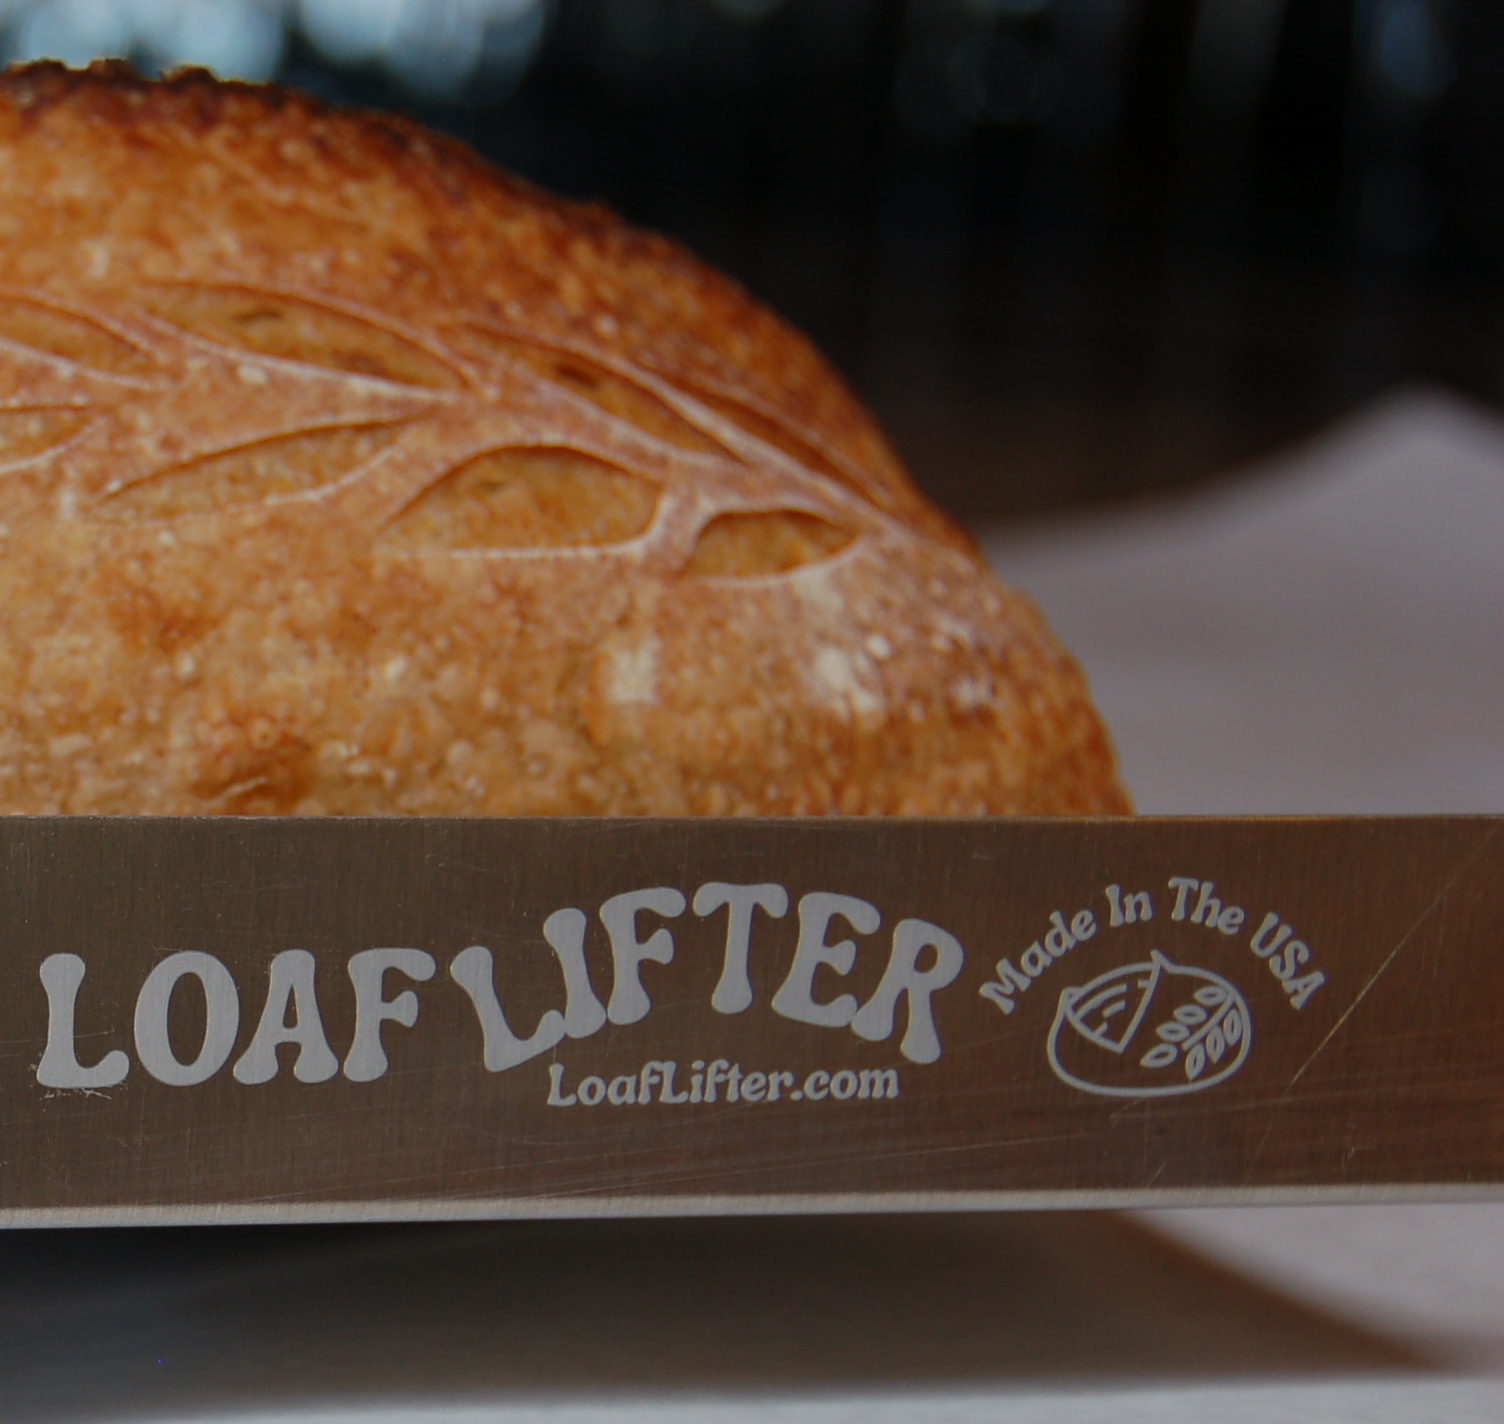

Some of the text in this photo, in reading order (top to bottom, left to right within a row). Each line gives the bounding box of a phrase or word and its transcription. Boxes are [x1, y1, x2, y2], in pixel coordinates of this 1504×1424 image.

[36, 947, 436, 1089] LOAF
[450, 882, 964, 1073] LIFTER
[979, 876, 1325, 1015] Made In The USA
[547, 1059, 900, 1107] LoafLifter.com
